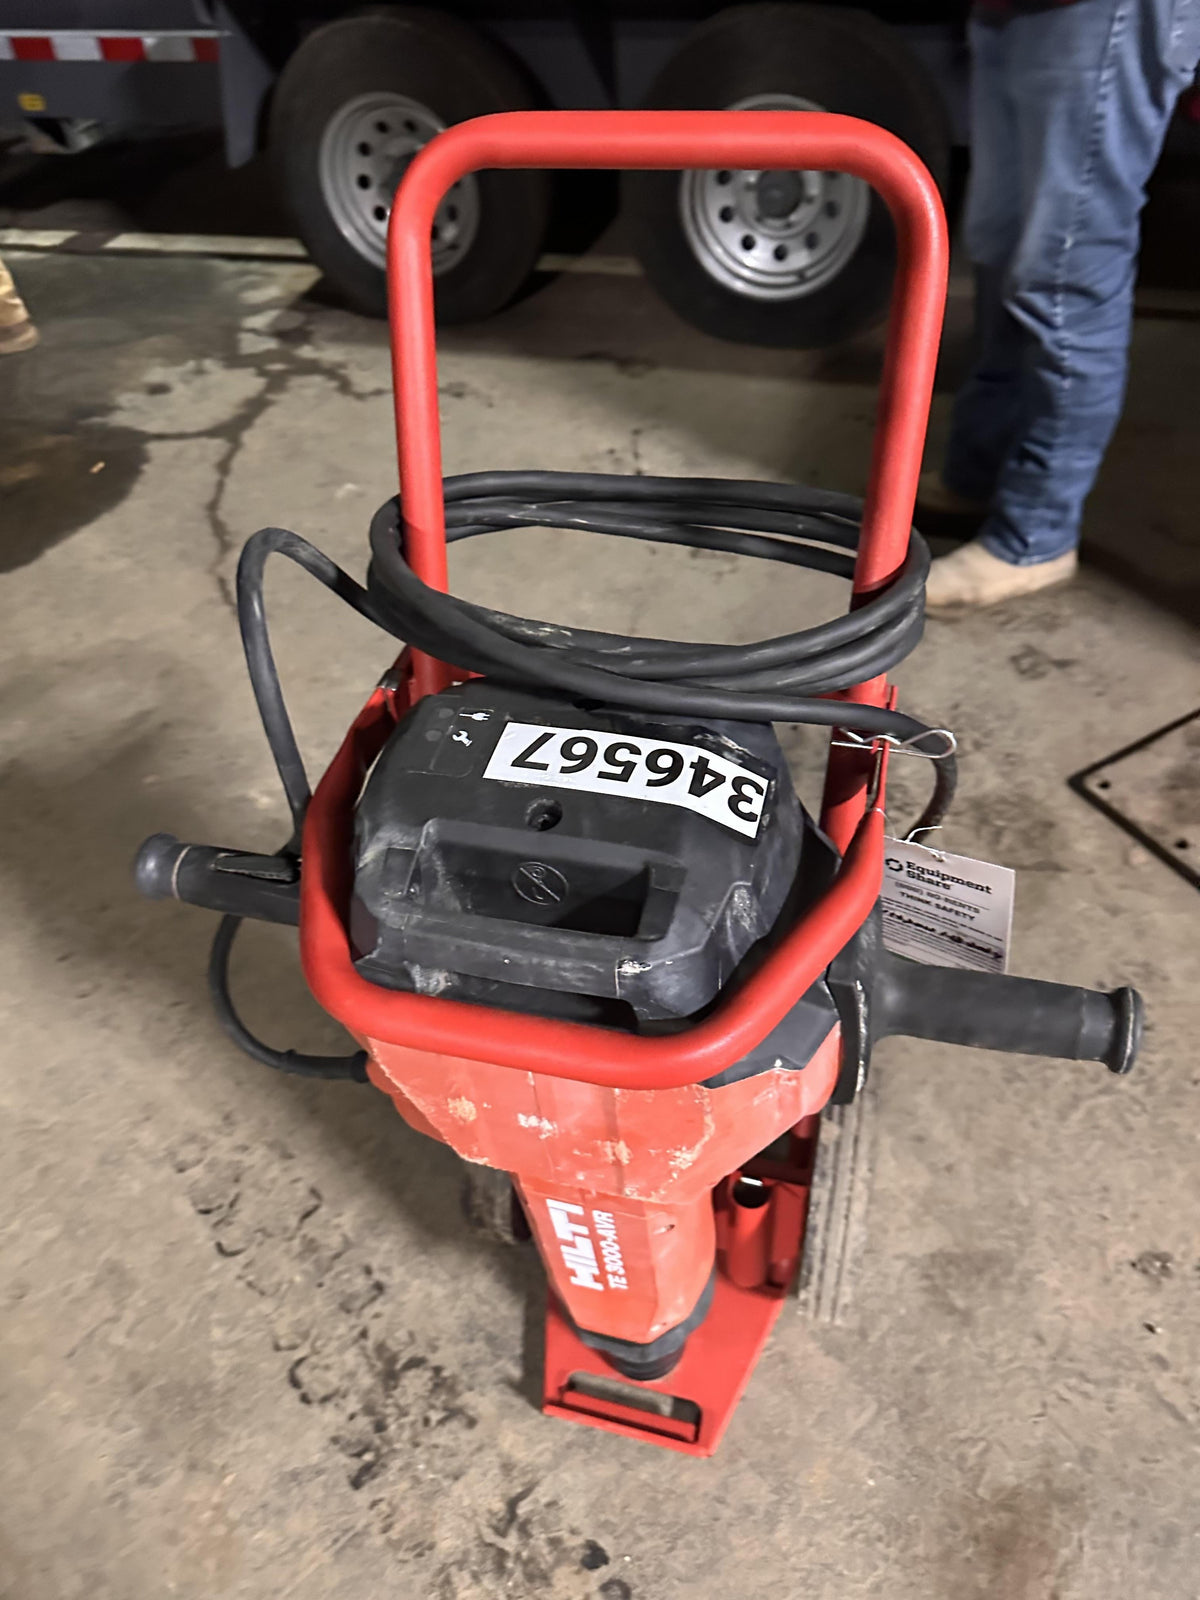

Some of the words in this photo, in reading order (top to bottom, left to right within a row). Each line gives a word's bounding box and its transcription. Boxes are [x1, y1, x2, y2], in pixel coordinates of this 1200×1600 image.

[511, 732, 763, 822] 346567
[906, 861, 992, 895] Equipment
[906, 870, 952, 890] Share
[934, 903, 975, 921] SAFETY
[545, 1198, 604, 1292] HILTI
[592, 1209, 625, 1275] 3000-AVR
[606, 1273, 629, 1290] TE
